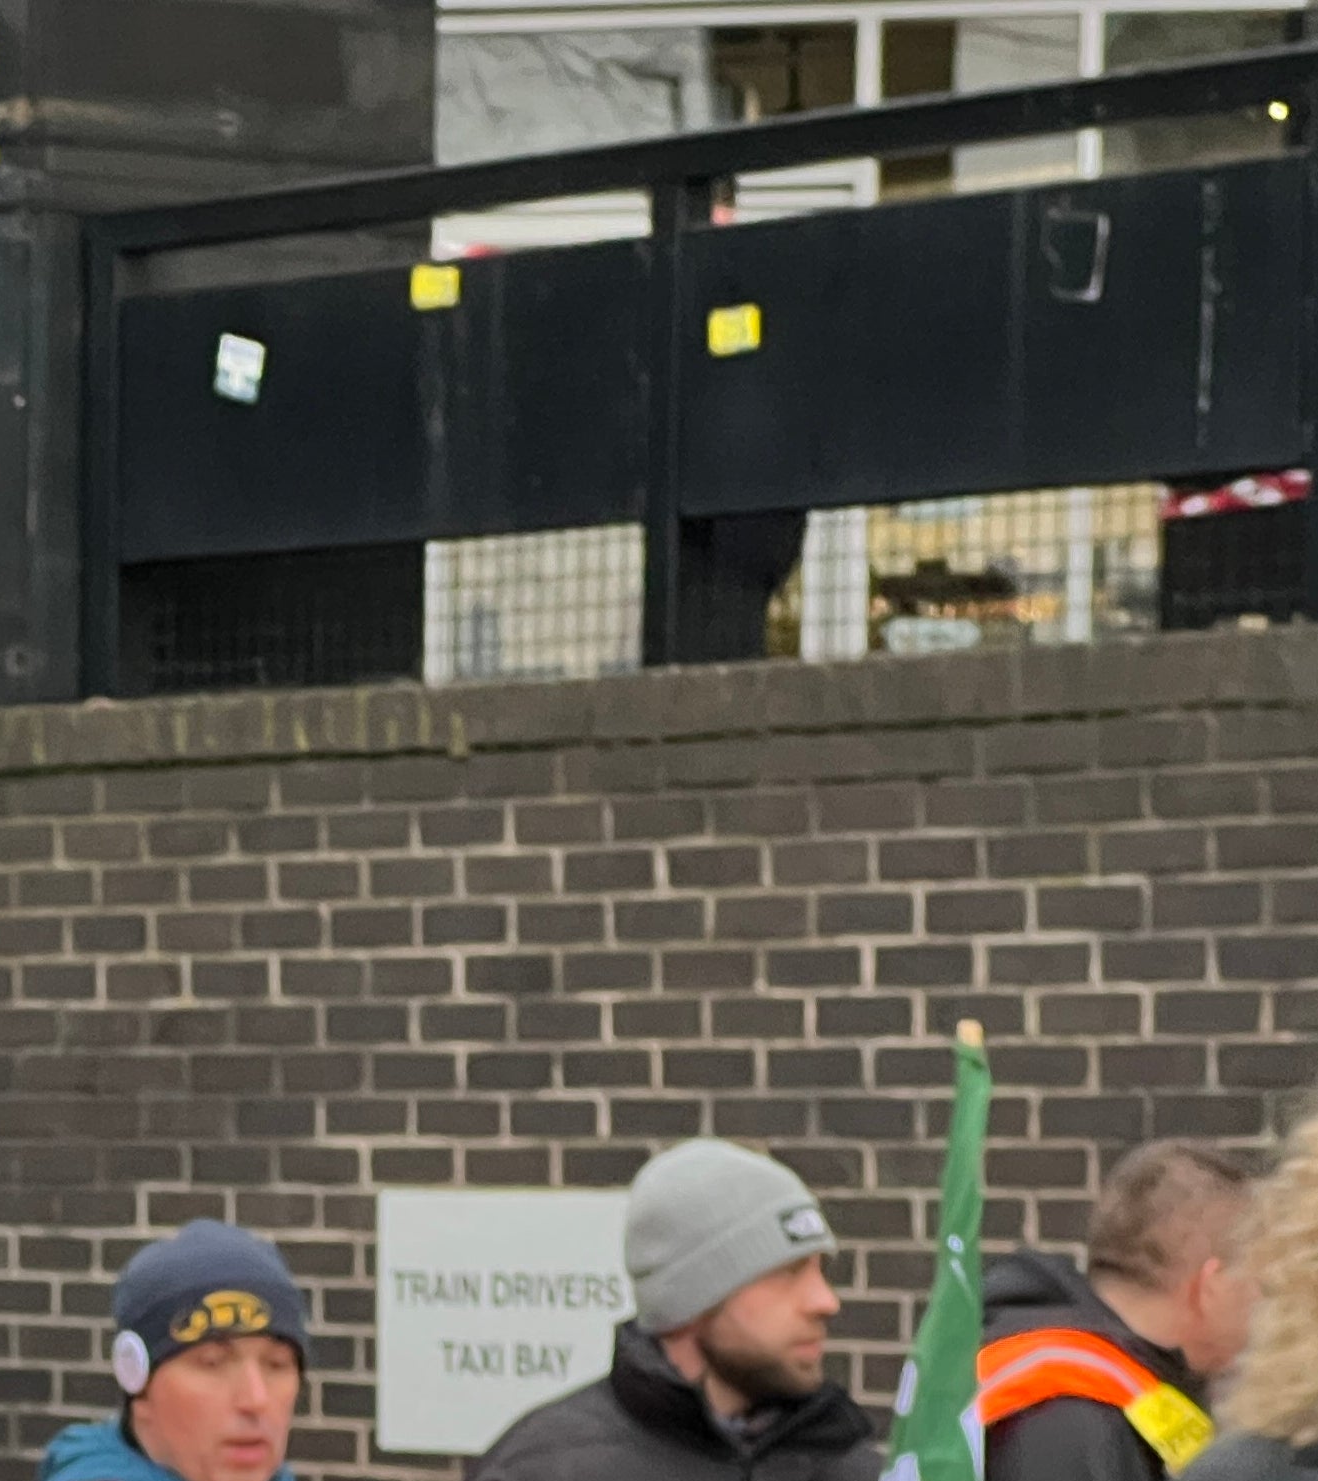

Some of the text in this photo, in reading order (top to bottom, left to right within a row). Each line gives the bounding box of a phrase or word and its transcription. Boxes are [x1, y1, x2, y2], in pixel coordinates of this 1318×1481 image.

[393, 1268, 623, 1308] TRAIN DRIVERS
[441, 1339, 573, 1378] TAXI BAY
